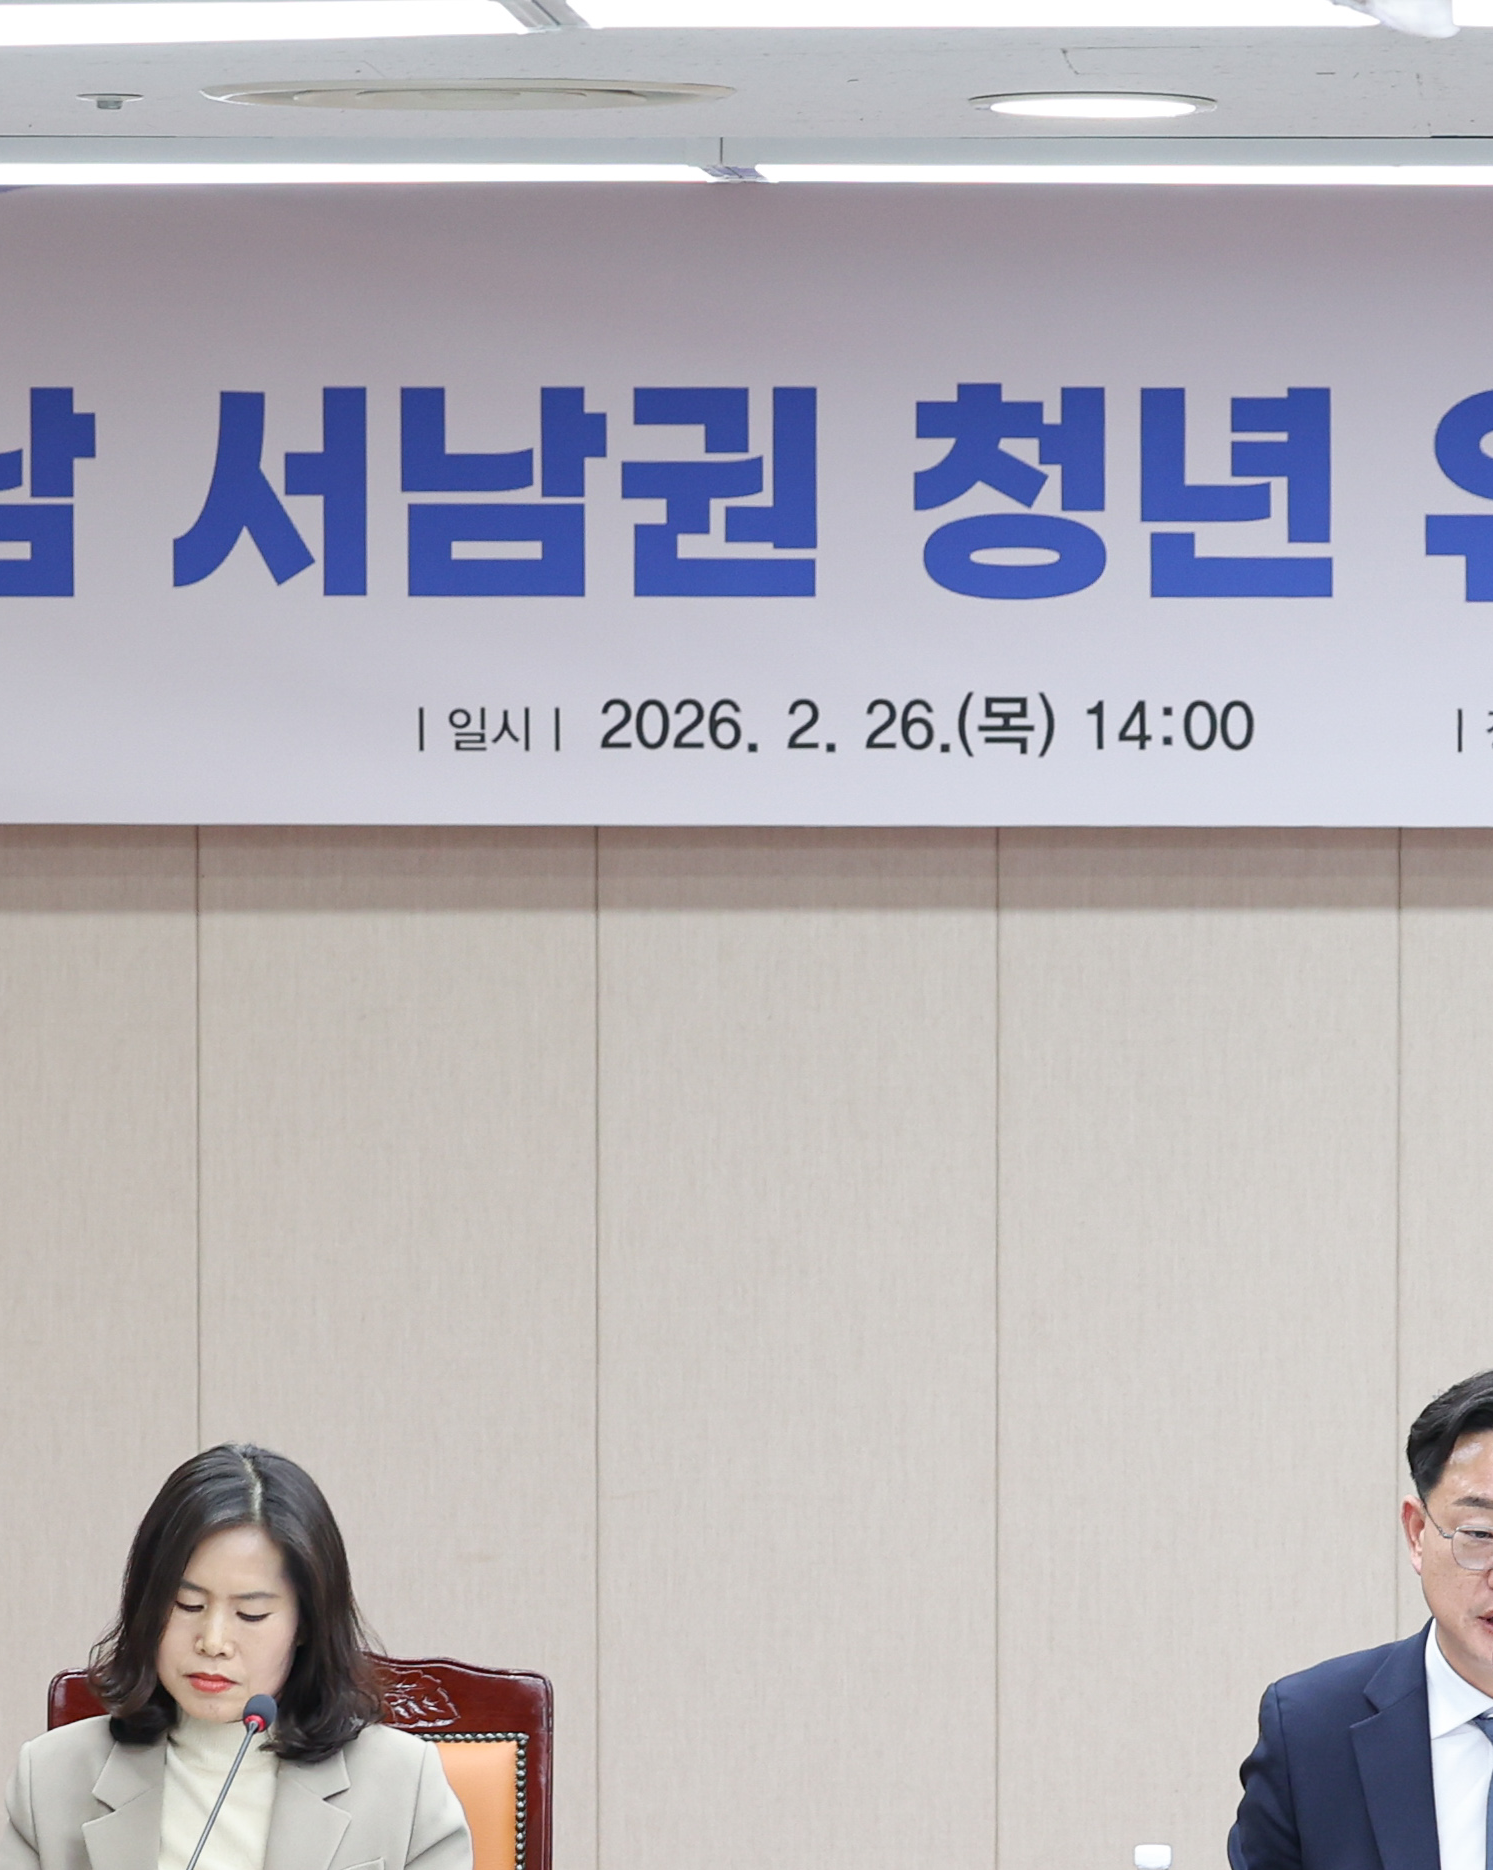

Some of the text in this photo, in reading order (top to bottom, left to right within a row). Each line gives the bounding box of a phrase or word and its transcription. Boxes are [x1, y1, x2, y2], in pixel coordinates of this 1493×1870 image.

[173, 386, 817, 597] 서남권
[914, 383, 1333, 600] 청년
[601, 699, 757, 752] 2026.
[788, 699, 835, 752] 2.
[866, 692, 1054, 757] 26.(목)
[1087, 699, 1254, 751] 14:00
